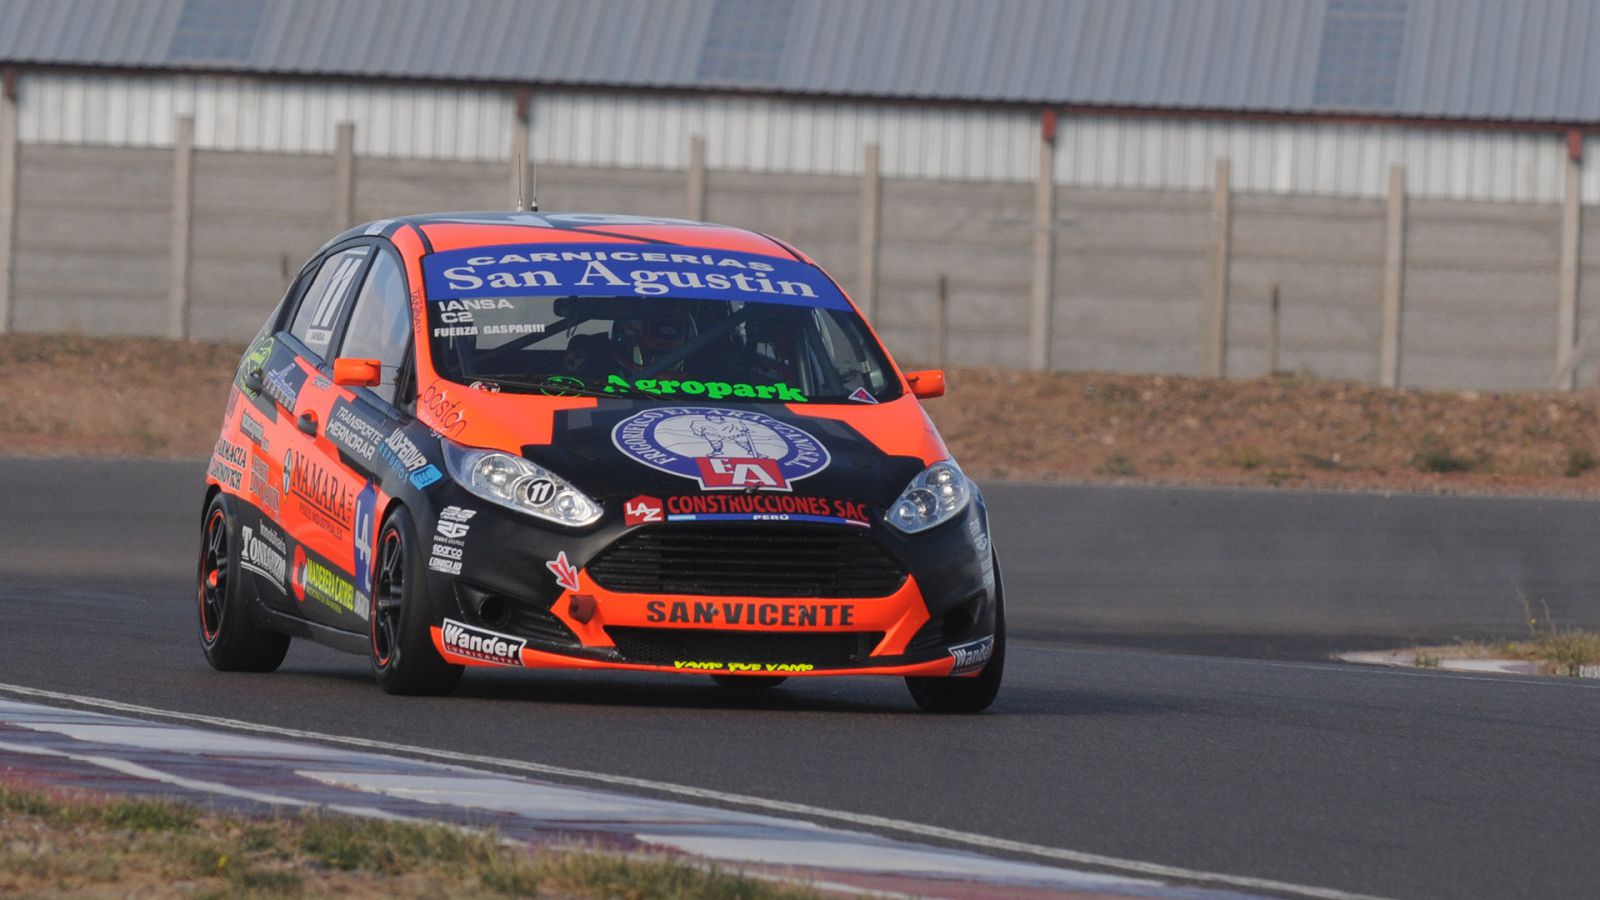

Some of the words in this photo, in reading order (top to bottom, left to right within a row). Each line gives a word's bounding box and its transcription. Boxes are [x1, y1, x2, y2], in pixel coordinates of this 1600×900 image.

[443, 265, 563, 291] San
[574, 259, 819, 298] Agustin
[310, 257, 363, 328] 11
[438, 299, 514, 312] IANSA
[441, 311, 474, 324] C2
[434, 326, 479, 338] FUERZA
[603, 374, 809, 402] Agropark
[335, 406, 385, 446] TRANSPORTE
[326, 418, 377, 462] HERNORAR
[292, 450, 347, 522] NAMARA
[531, 482, 552, 502] 11
[626, 502, 662, 522] LAZ
[667, 495, 830, 516] CONSTRUCCIONES
[834, 500, 870, 521] SAC
[432, 543, 463, 558] sparco
[647, 600, 714, 623] SAN
[722, 603, 855, 627] VICENTE
[445, 623, 519, 658] Wander
